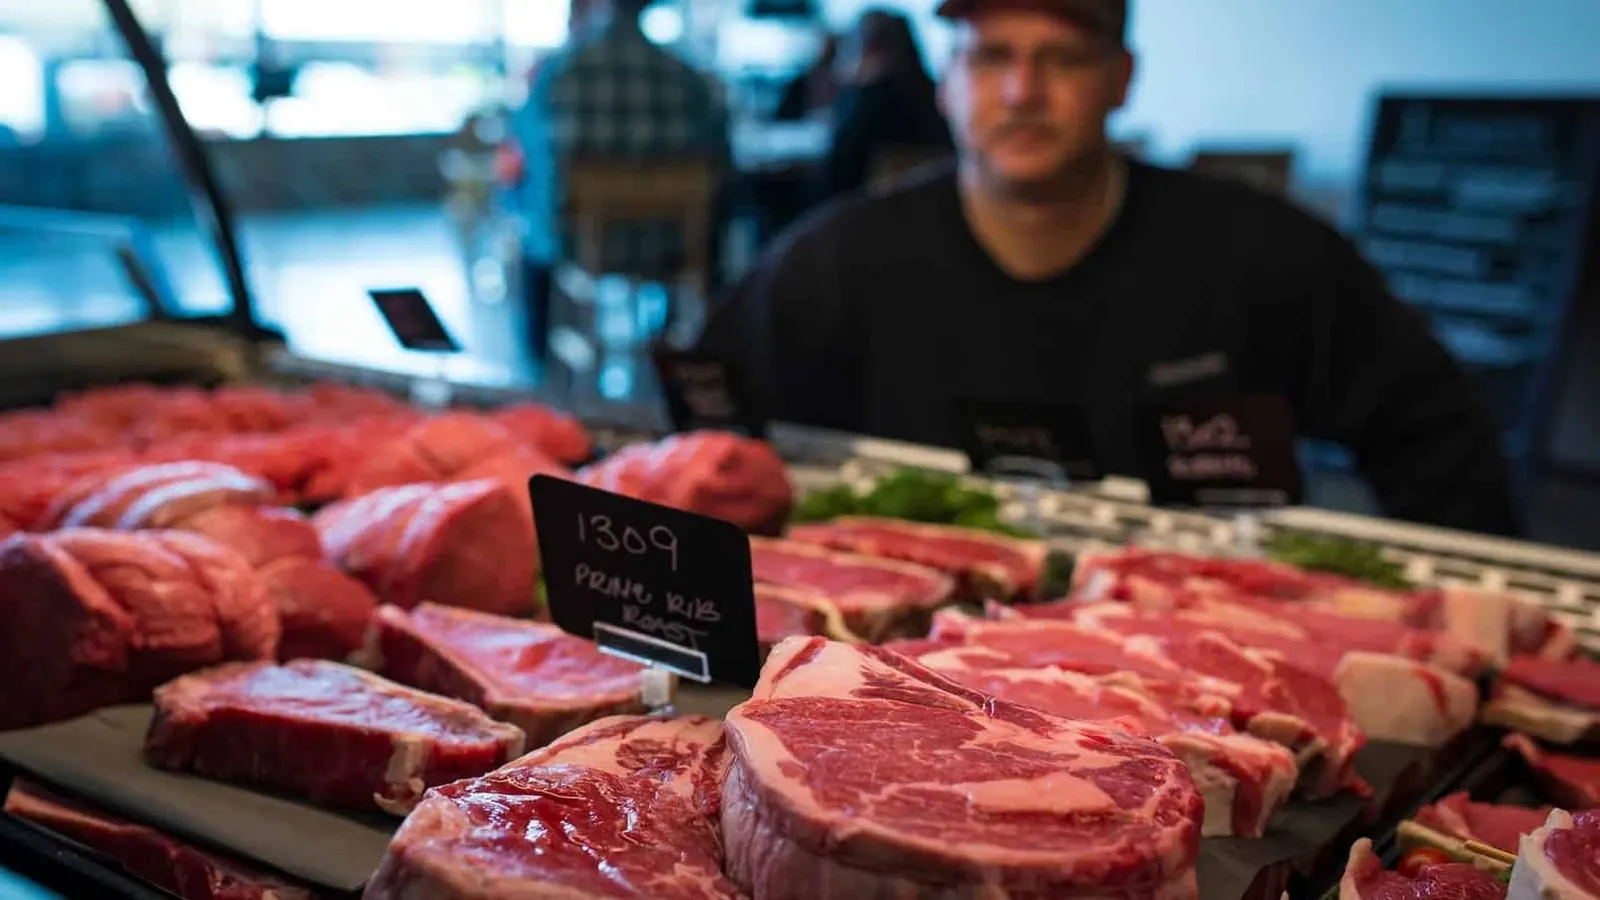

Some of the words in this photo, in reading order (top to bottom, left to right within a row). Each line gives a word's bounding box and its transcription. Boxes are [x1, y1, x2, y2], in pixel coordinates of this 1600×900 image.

[578, 512, 678, 571] 1309
[622, 604, 710, 651] ROAST
[666, 591, 722, 622] RIB
